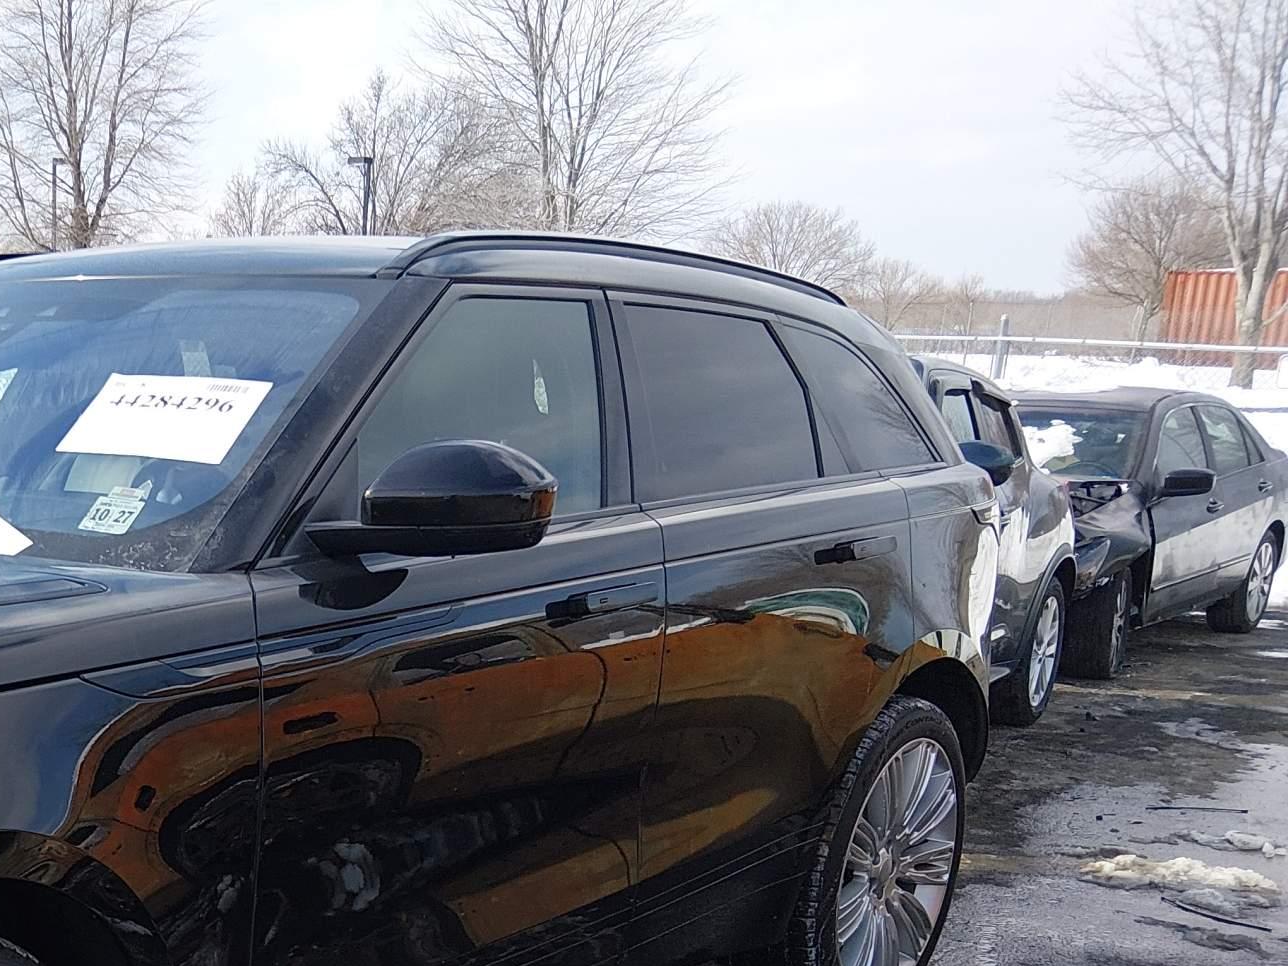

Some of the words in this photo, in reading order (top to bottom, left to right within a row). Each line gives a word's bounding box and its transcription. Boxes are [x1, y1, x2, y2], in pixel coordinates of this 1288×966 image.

[110, 394, 234, 413] 44284296
[90, 508, 111, 521] 10
[113, 510, 135, 524] 27
